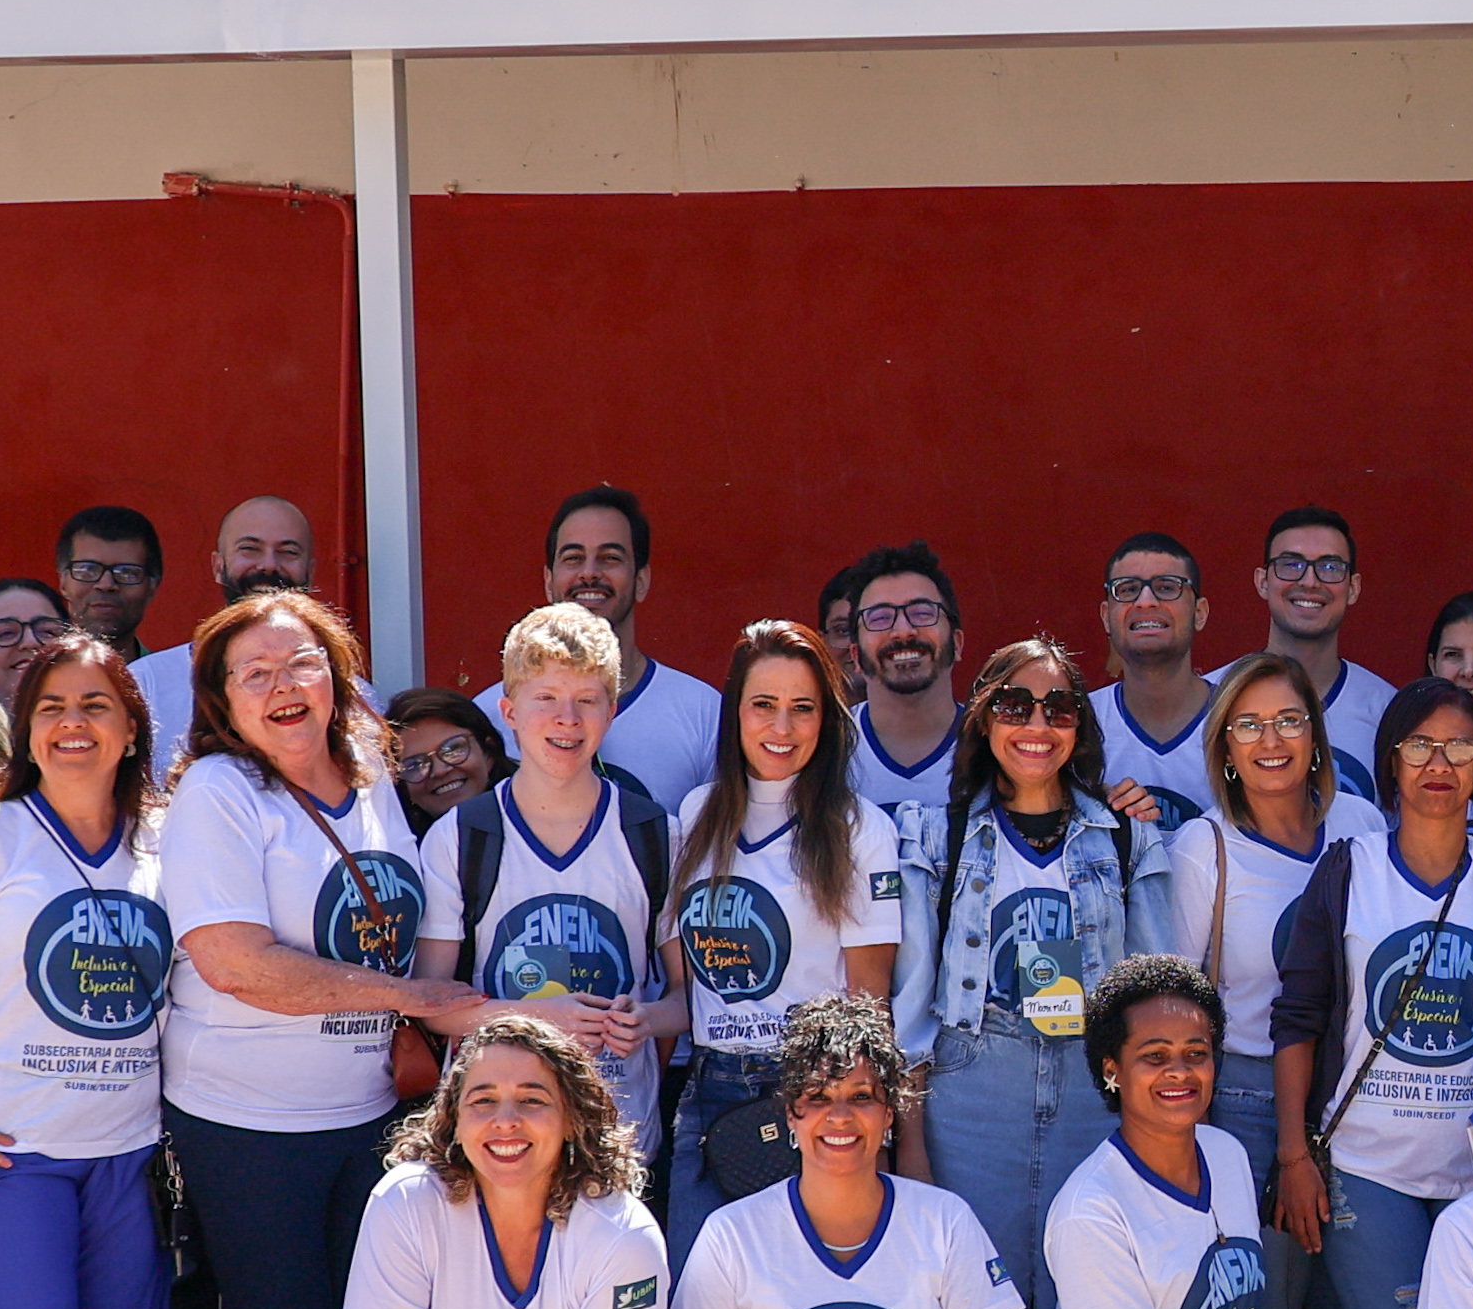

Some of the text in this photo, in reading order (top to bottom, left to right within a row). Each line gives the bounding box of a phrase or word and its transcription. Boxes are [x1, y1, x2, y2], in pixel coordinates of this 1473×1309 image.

[72, 897, 146, 947] ENEM
[525, 904, 600, 953] ENEM
[71, 948, 128, 971] Inclusivo
[79, 971, 135, 997] Especial
[1399, 980, 1456, 1004] Iclusivo
[1403, 999, 1460, 1024] Especial
[321, 1017, 379, 1034] INCLUSIVA
[23, 1044, 112, 1057] SUBSECRETARIA
[115, 1047, 127, 1057] DE
[22, 1058, 96, 1073] INCLUSIVA
[102, 1061, 109, 1073] E
[64, 1081, 131, 1091] SUBIN/SEEDF
[1435, 1073, 1448, 1085] DE
[1425, 1087, 1432, 1100] E
[1392, 1109, 1456, 1120] SUBIN/SEEDF
